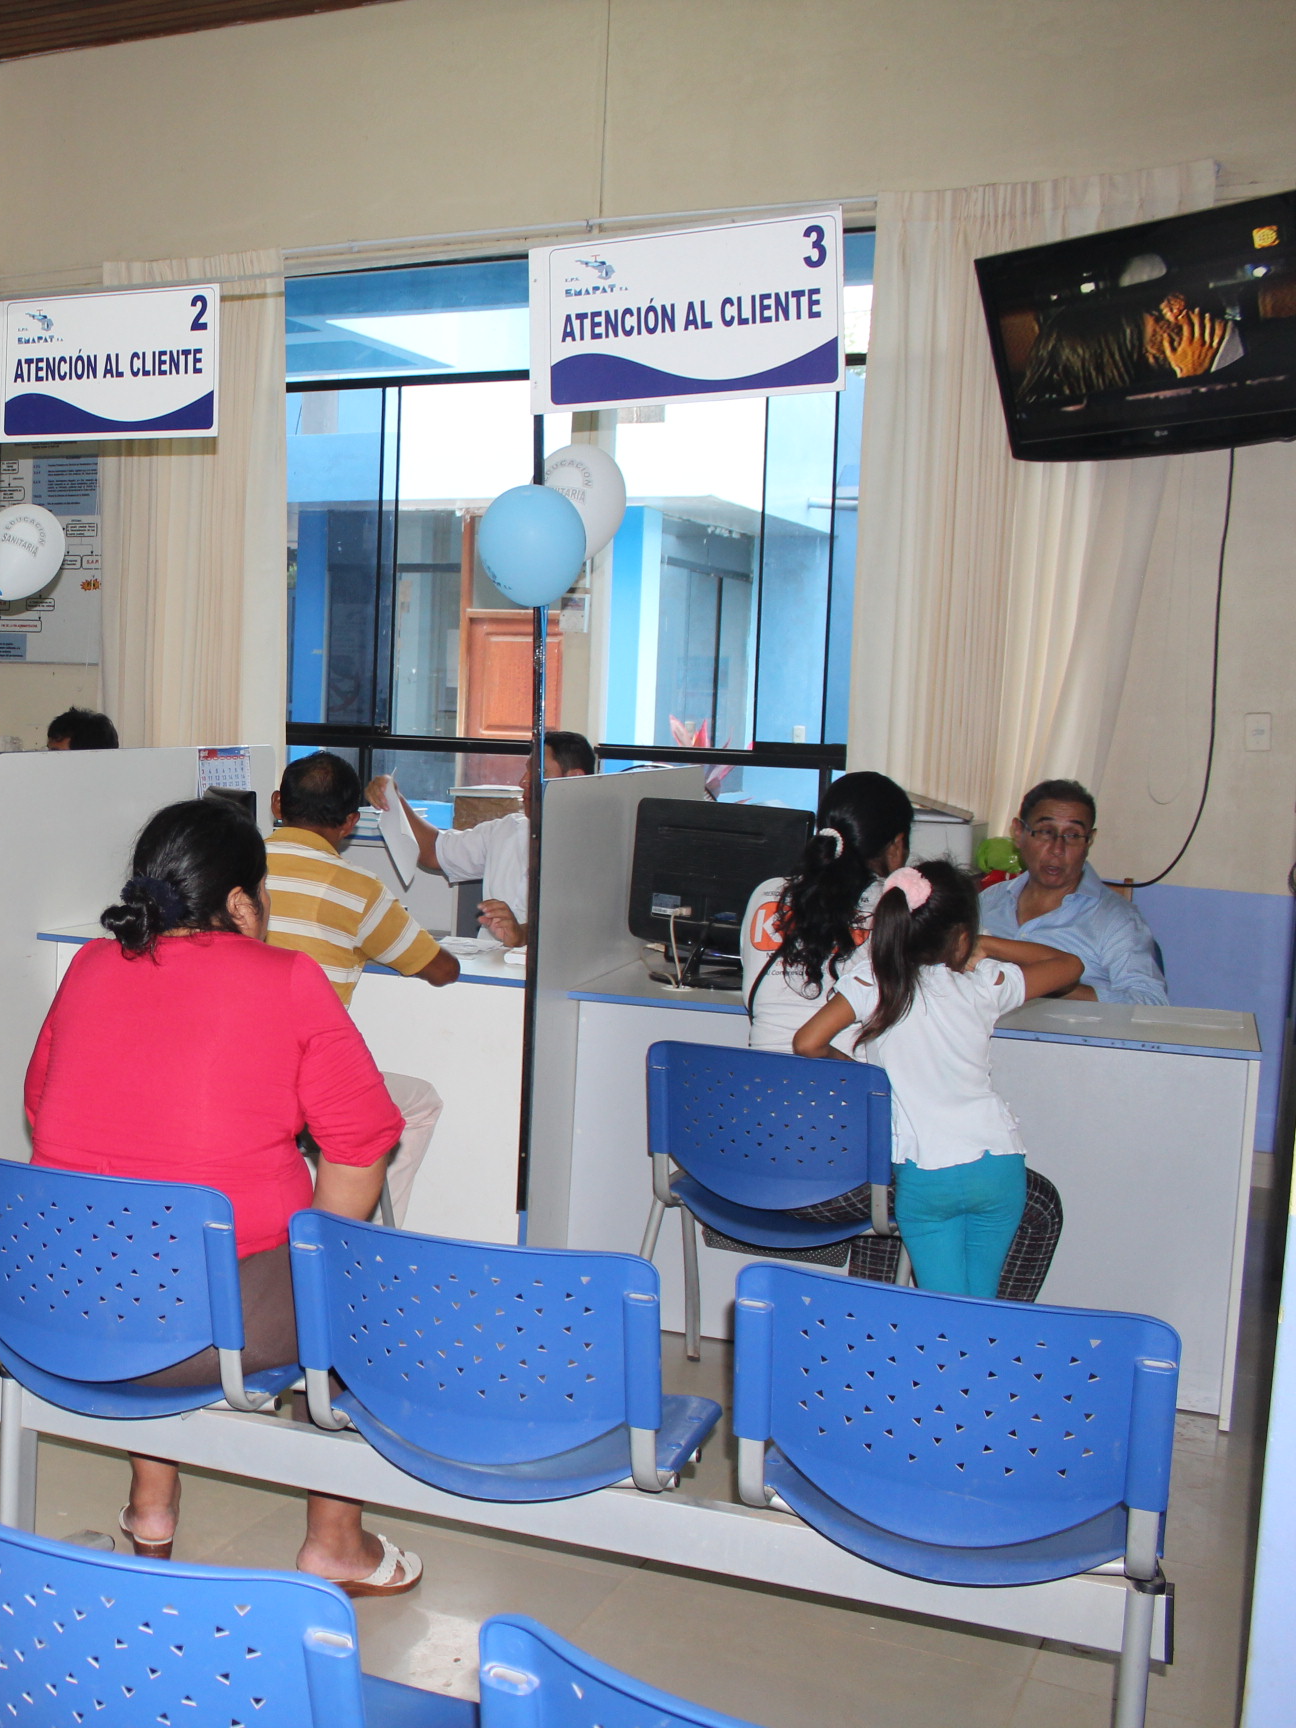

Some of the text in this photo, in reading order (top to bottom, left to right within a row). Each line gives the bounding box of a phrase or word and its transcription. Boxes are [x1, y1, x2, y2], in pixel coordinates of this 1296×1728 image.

[803, 224, 826, 268] 3
[565, 283, 616, 298] EMAPAT
[190, 294, 208, 331] 2
[561, 288, 822, 343] ATENCIÓN AL CLIENTE
[17, 335, 54, 344] EMAPAT
[14, 348, 203, 383] ATENCIÓN AL CLIENTE
[2, 532, 39, 557] SANITARIA
[754, 908, 783, 943] K
